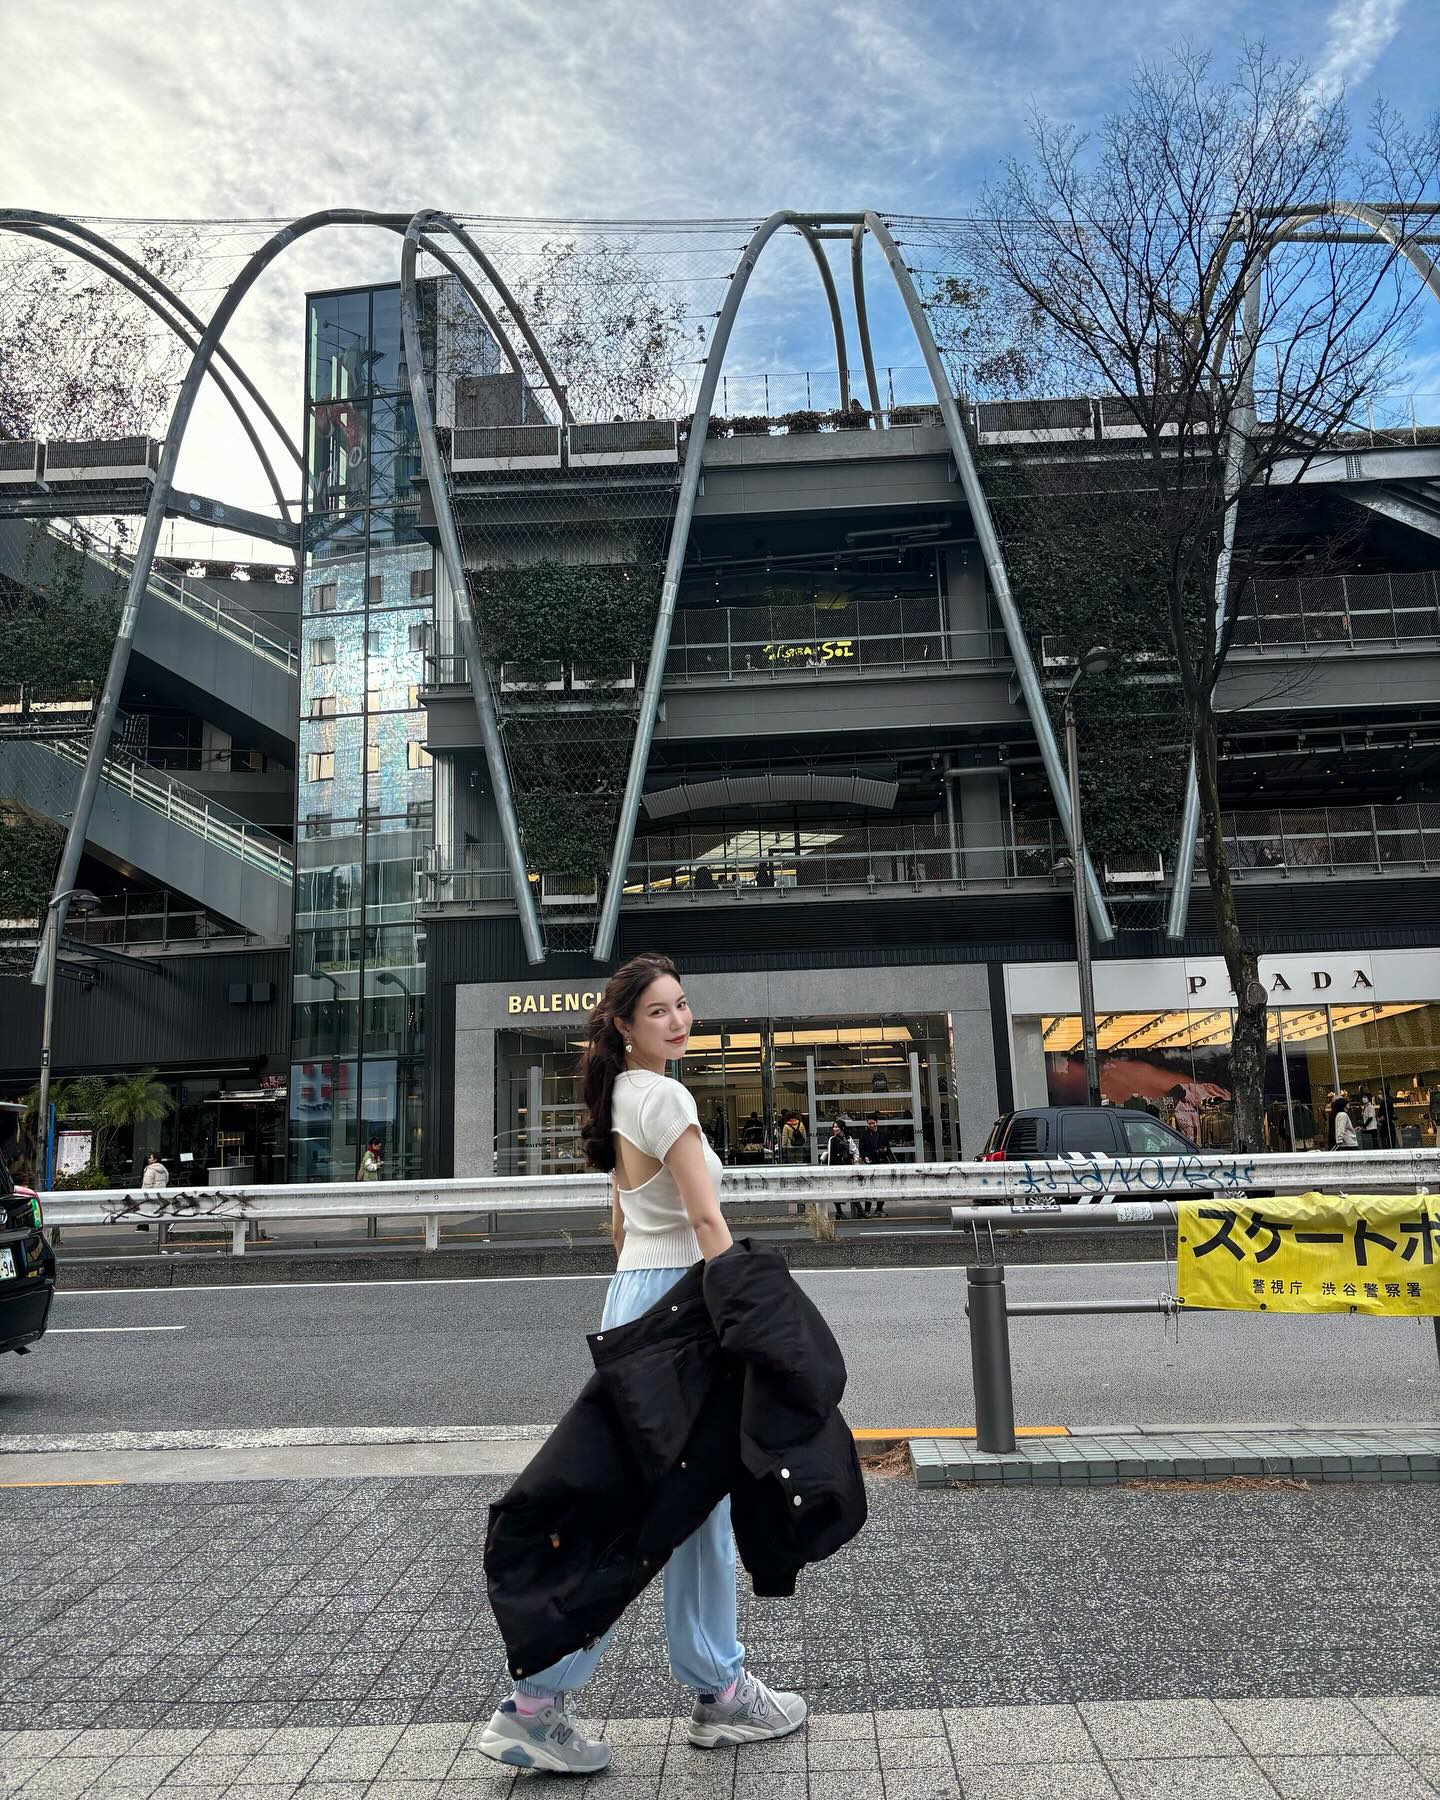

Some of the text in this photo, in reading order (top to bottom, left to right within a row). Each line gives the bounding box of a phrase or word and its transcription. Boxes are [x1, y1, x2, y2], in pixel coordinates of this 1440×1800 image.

[1252, 1278, 1422, 1299] 警視庁 渋谷警察署
[550, 1722, 573, 1745] N
